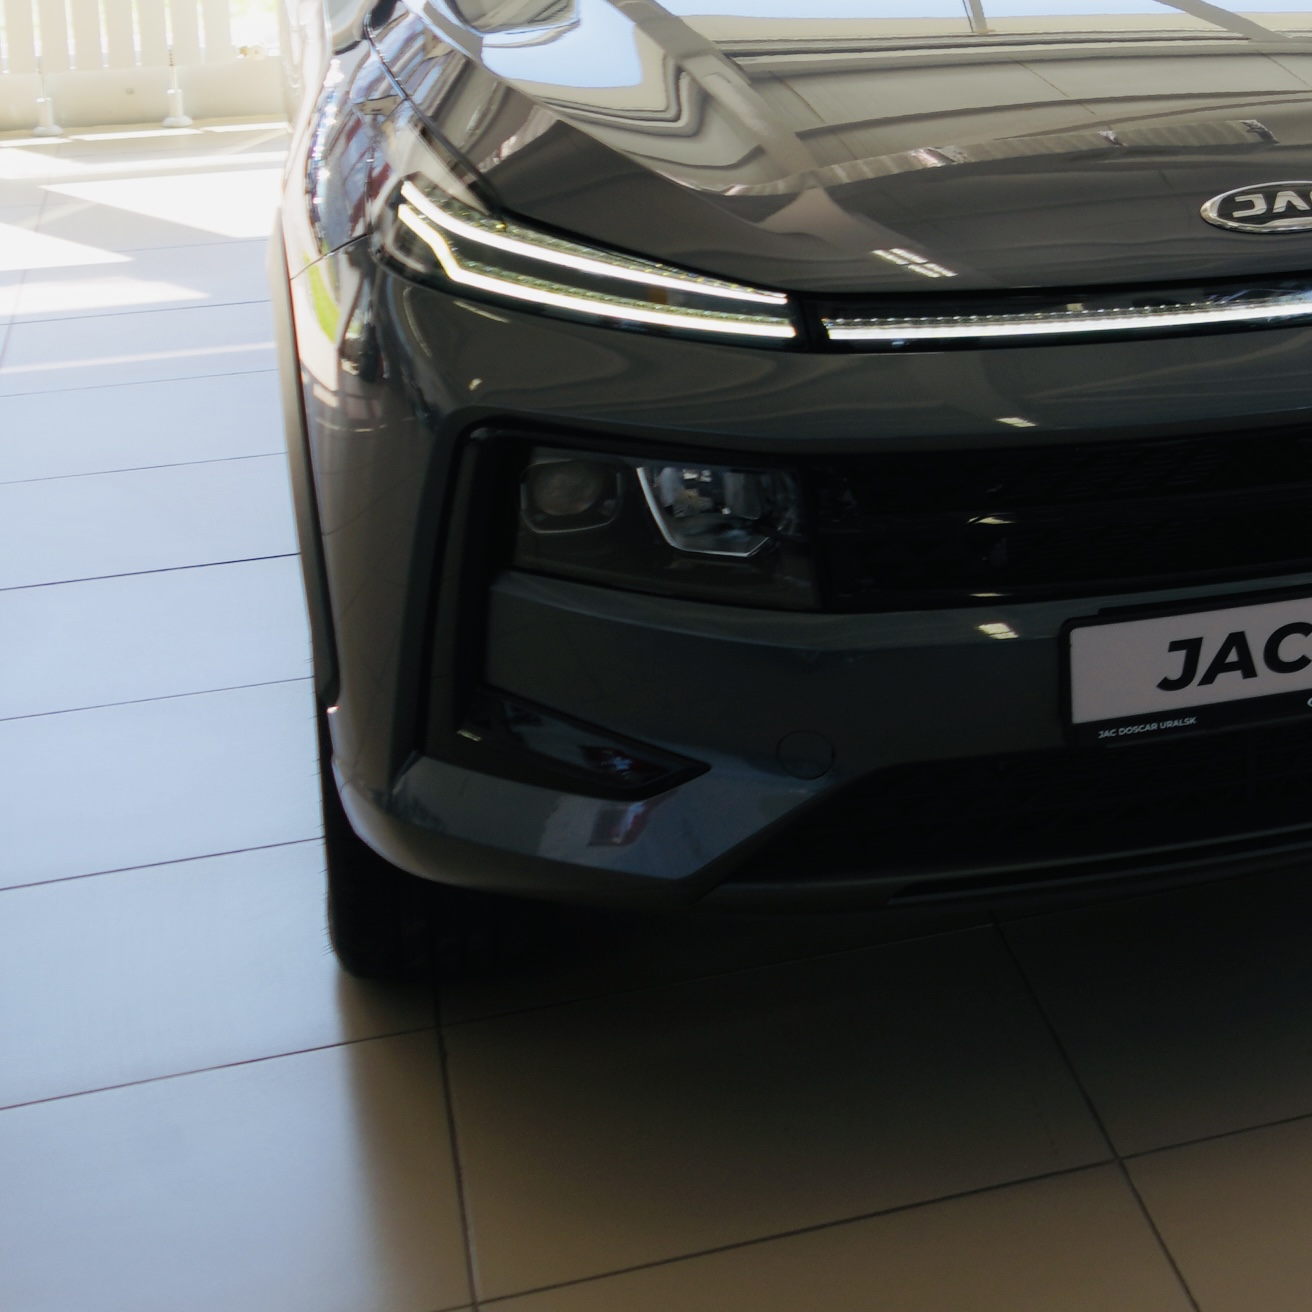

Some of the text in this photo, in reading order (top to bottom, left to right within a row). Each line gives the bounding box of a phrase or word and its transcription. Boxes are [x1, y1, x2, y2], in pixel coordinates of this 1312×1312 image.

[1098, 716, 1197, 739] JAC DOSCAR URALSK
